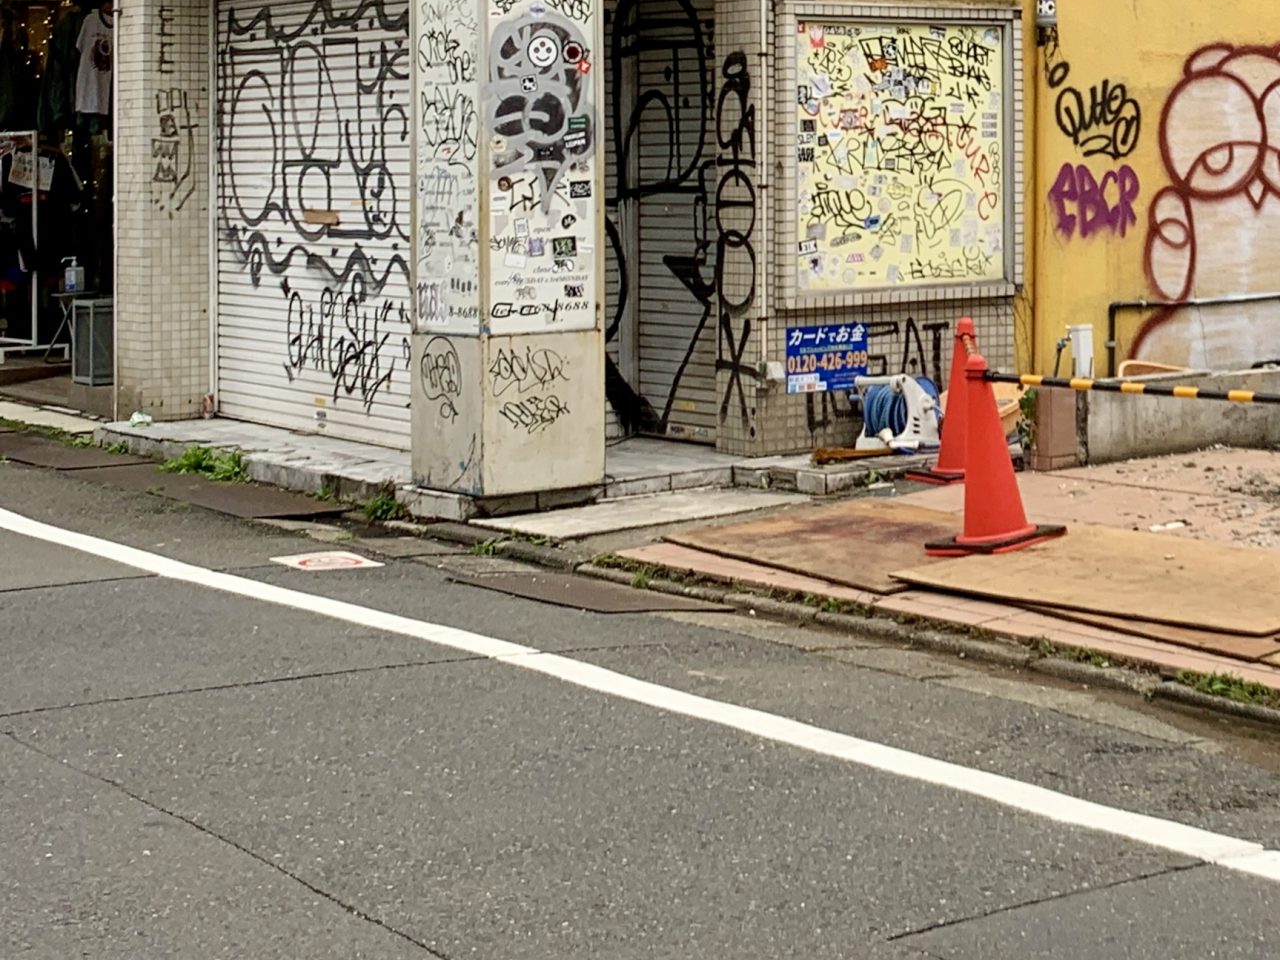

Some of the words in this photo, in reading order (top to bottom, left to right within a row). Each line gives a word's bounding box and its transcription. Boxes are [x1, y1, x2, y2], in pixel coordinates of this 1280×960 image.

[1037, 0, 1055, 15] HC
[788, 324, 866, 347] カードでお金
[787, 350, 868, 374] 0120-426-999
